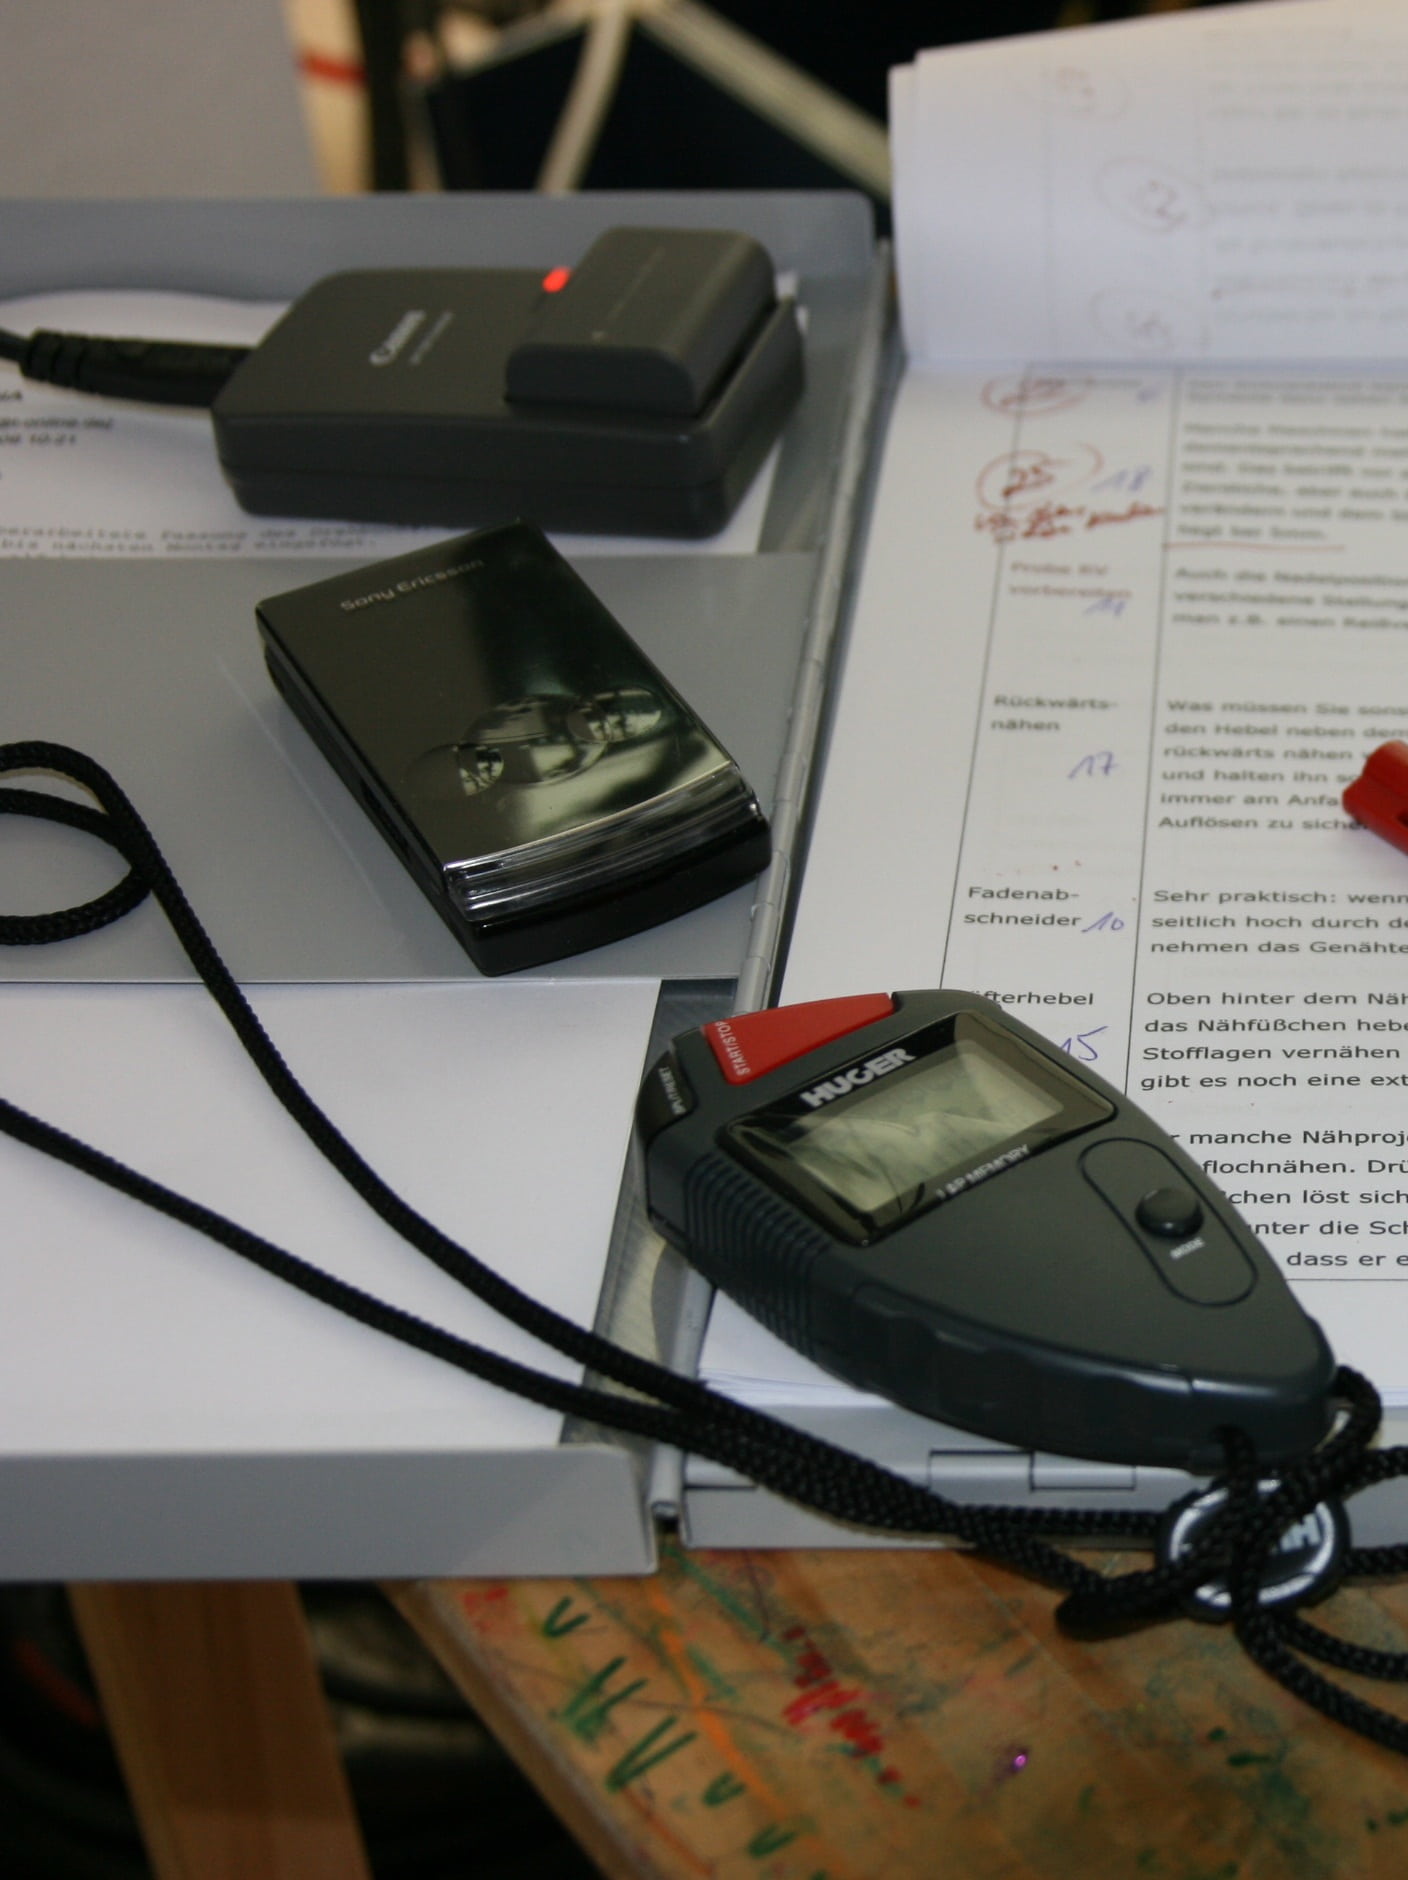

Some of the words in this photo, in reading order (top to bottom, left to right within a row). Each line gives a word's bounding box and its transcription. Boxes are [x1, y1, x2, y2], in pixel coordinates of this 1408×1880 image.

[340, 588, 395, 611] Sony
[397, 559, 485, 592] Ericsson
[994, 694, 1118, 710] Rückwärts-
[1168, 701, 1213, 712] Was
[1221, 703, 1307, 714] müssen
[1316, 704, 1349, 715] Sie
[991, 718, 1061, 731] nähen
[1067, 750, 1119, 779] 17
[1162, 770, 1204, 780] und
[1214, 770, 1284, 782] halten
[1293, 771, 1328, 782] ihn
[1161, 793, 1235, 804] immer
[1243, 795, 1279, 805] am
[1288, 794, 1339, 806] Anfa
[1158, 816, 1258, 828] Auflösen
[1268, 820, 1293, 829] zu
[968, 887, 1080, 900] Fadenab-
[1154, 890, 1209, 902] Sehr
[1219, 891, 1335, 904] praktisch:
[963, 912, 1082, 926] schneider
[1081, 911, 1124, 934] 10
[1152, 916, 1235, 928] seitlich
[1246, 916, 1302, 928] hoch
[1311, 917, 1379, 928] durch
[1151, 941, 1248, 952] nehmen
[1258, 941, 1300, 953] das
[980, 990, 1094, 1005] fterhebel
[1147, 992, 1211, 1005] Oben
[1222, 992, 1295, 1005] hinter
[1304, 992, 1357, 1005] dem
[1145, 1020, 1188, 1032] das
[1198, 1019, 1346, 1032] Nähfüßchen
[715, 1020, 751, 1077] START/STOP
[1060, 1026, 1108, 1061] 15
[1143, 1047, 1271, 1062] Stofflagen
[1282, 1045, 1400, 1059] vernähen
[800, 1048, 917, 1108] HUGER
[1141, 1075, 1190, 1091] gibt
[1200, 1077, 1227, 1087] es
[1238, 1073, 1296, 1087] noch
[1307, 1074, 1360, 1086] eine
[1190, 1130, 1292, 1144] manche
[1202, 1160, 1356, 1175] flochnähen.
[1303, 1190, 1350, 1204] löst
[1255, 1221, 1310, 1235] nter
[1319, 1220, 1359, 1235] die
[1286, 1251, 1348, 1266] dass
[1358, 1255, 1387, 1267] er
